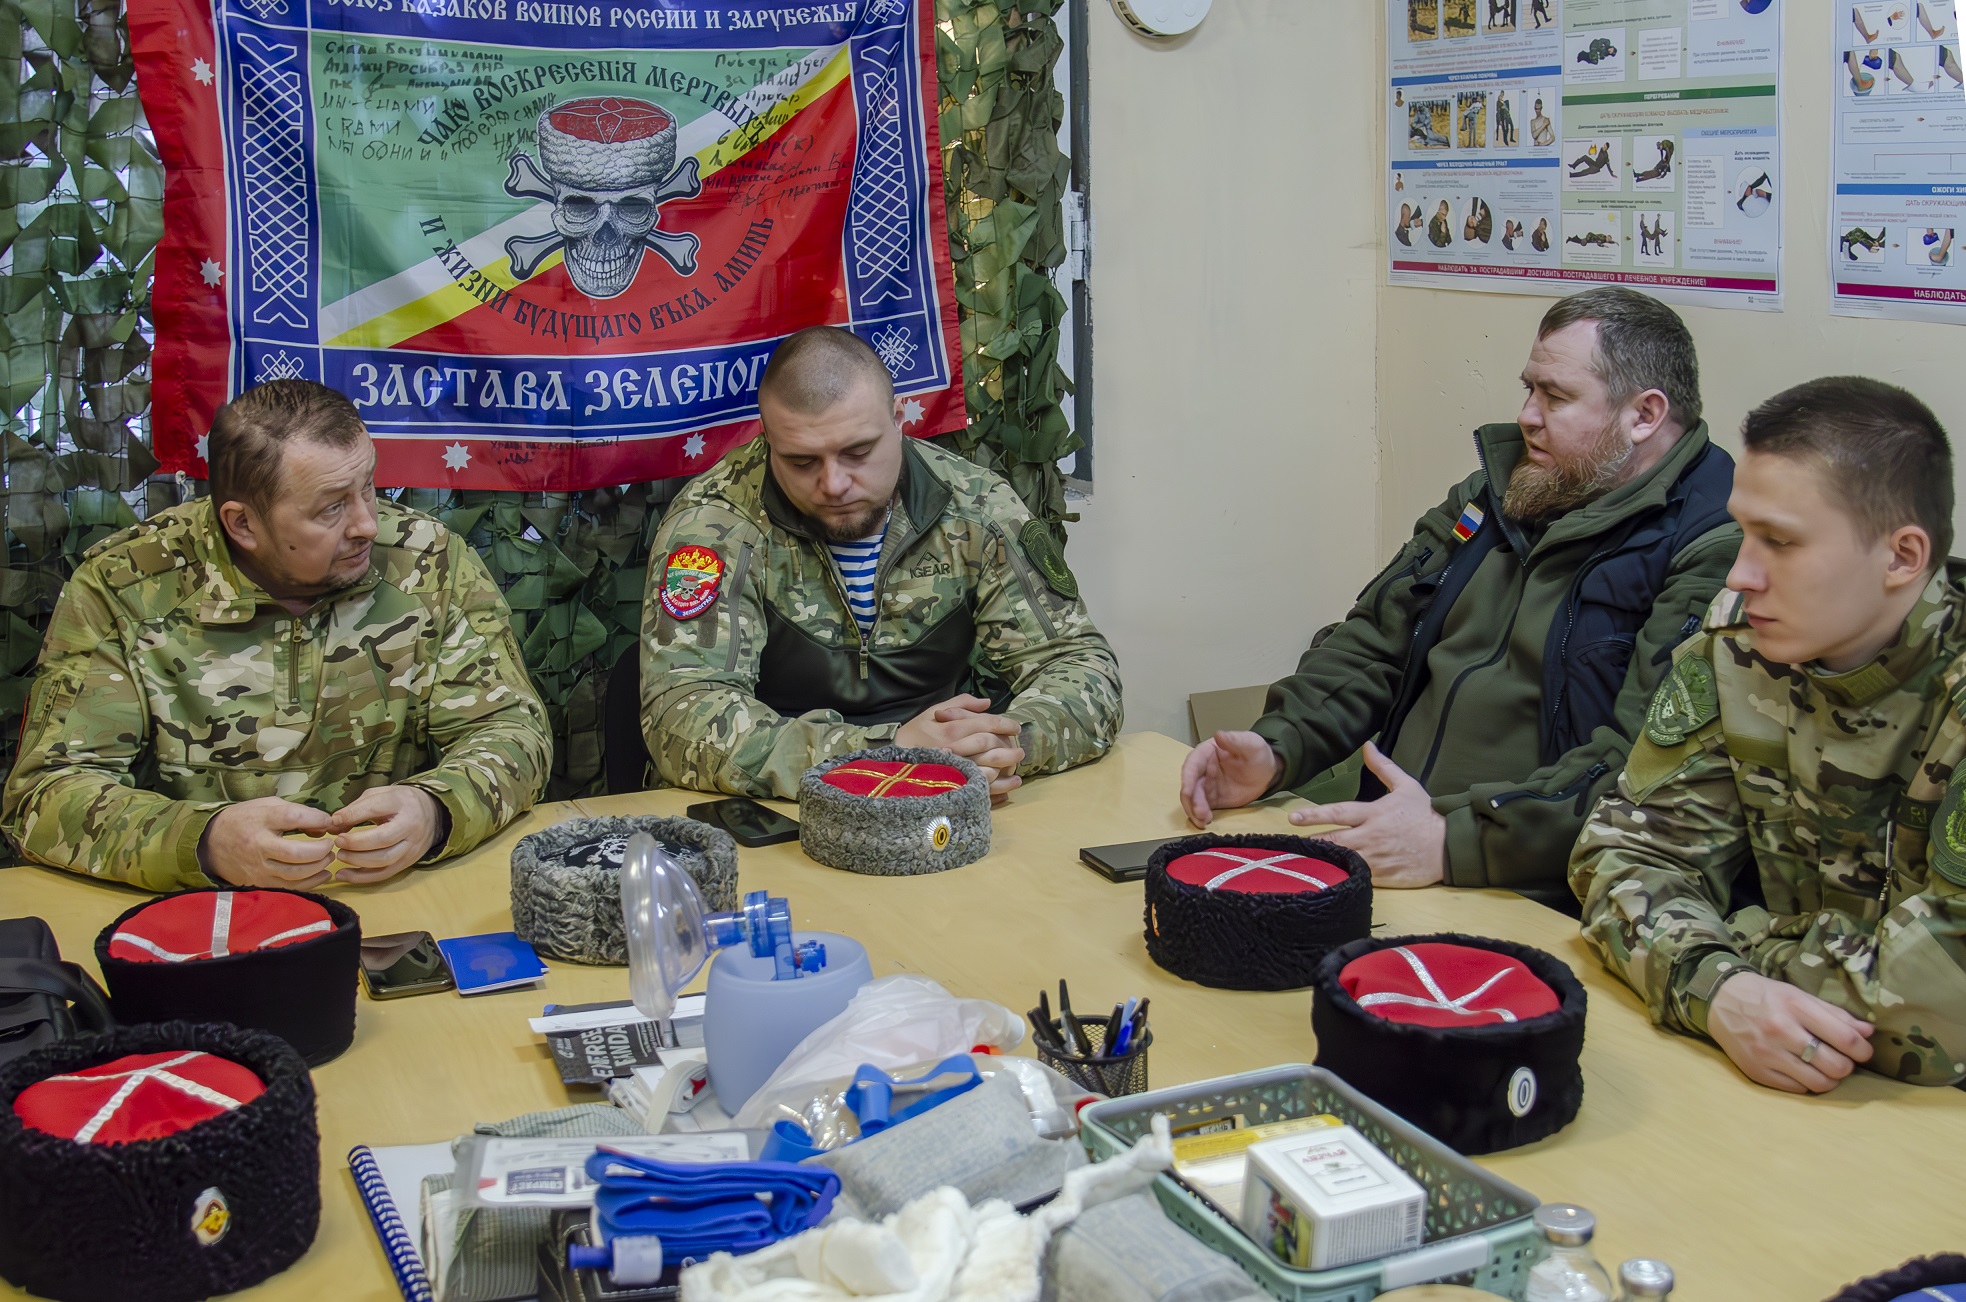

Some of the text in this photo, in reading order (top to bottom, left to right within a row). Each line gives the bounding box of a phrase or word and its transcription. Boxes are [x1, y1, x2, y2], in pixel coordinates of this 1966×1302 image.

[401, 0, 506, 20] КАЗАКОВ
[515, 1, 601, 26] ВОИНОВ
[609, 7, 698, 30] РОССИИ
[704, 10, 721, 29] И
[727, 2, 858, 32] ЗАРУБЕЖЬЯ
[417, 99, 469, 147] ЧАЮ
[419, 215, 447, 236] И
[432, 238, 513, 315] ЖИЗНИ
[713, 217, 774, 293] АМИНЬ
[1438, 264, 1468, 273] НАБЛЮДАТЬ
[1526, 269, 1560, 277] ДОСТАВИТЬ
[1563, 271, 1615, 281] ПОСТРАДАВШЕГО
[1624, 275, 1657, 283] ЛЕЧЕБНОЕ
[1660, 277, 1707, 287] УЧРЕЖДЕНИЕ!
[1914, 290, 1966, 301] НАБЛЮДАТЬ
[512, 298, 641, 345] БУДУЩАГО
[352, 353, 770, 416] ЗАСТАВА ЗЕЛЕНОГ
